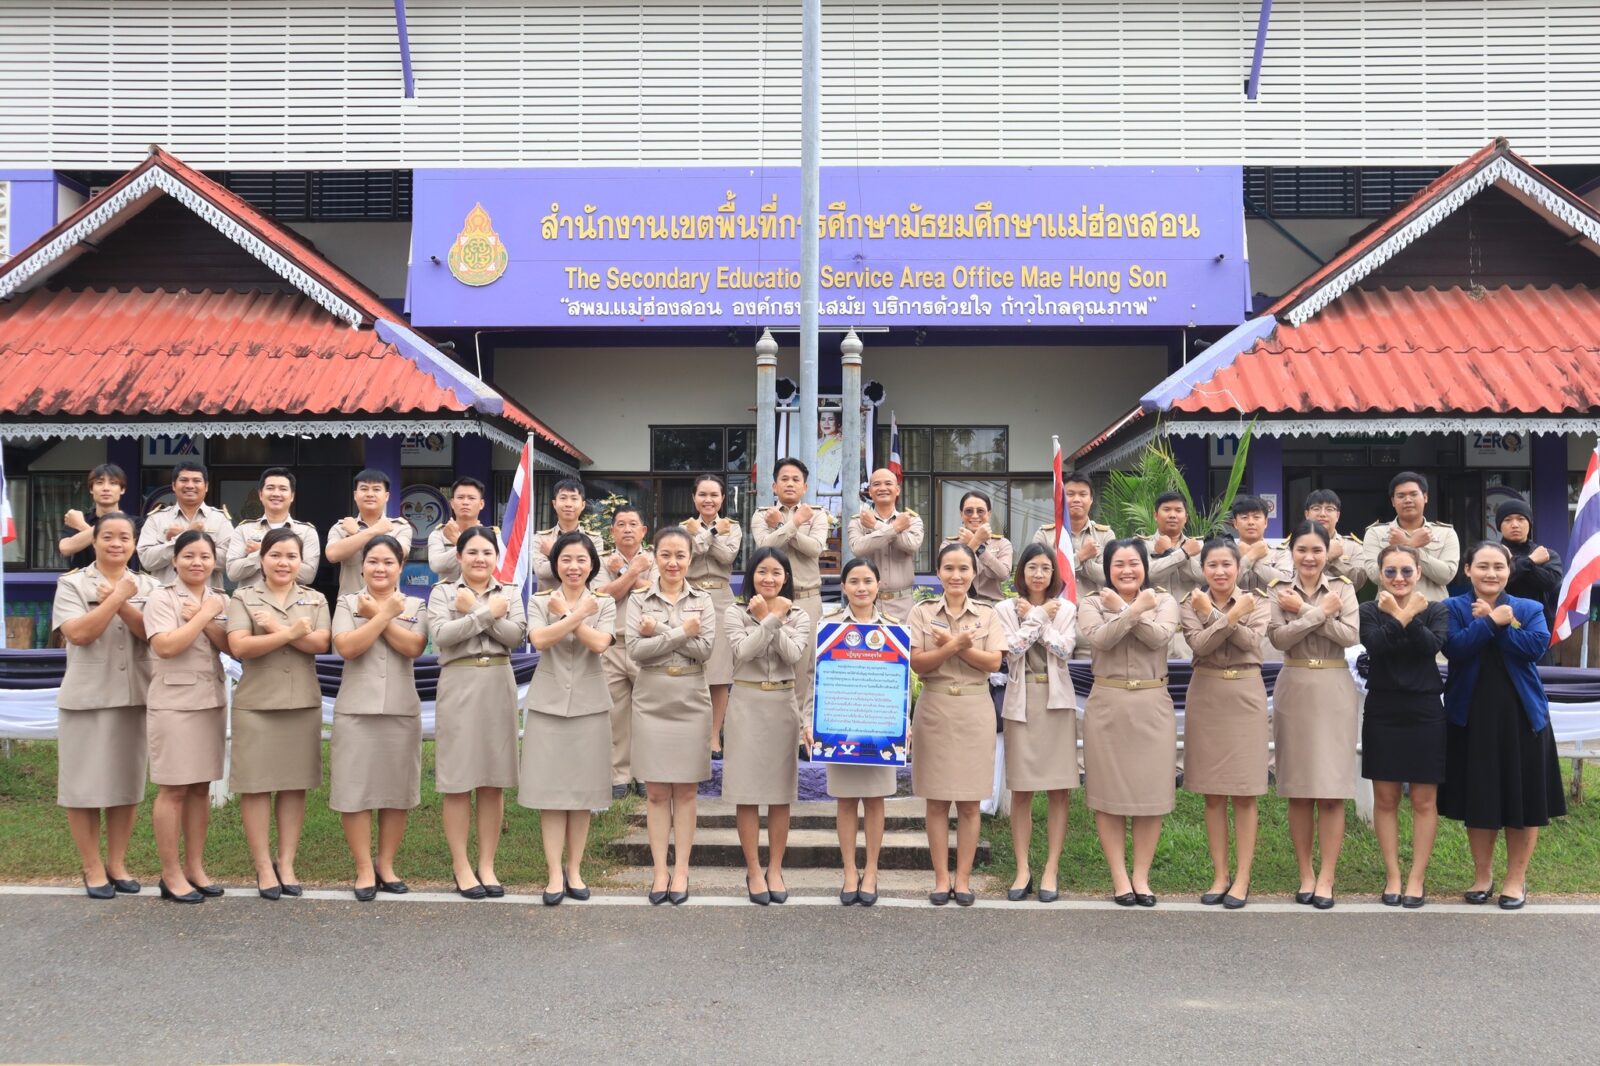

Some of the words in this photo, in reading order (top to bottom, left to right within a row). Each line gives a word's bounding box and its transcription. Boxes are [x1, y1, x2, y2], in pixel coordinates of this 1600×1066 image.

[564, 266, 600, 290] The
[606, 266, 711, 294] Secondary
[716, 266, 803, 290] Educatio
[820, 264, 894, 289] Service
[899, 265, 946, 289] Area
[952, 264, 1014, 289] Office
[1021, 265, 1063, 289] Mae
[1069, 265, 1121, 294] Hong
[1128, 264, 1168, 289] Son
[733, 295, 866, 317] องค์กรนสมัย
[872, 294, 993, 316] บริการด้วยใจ
